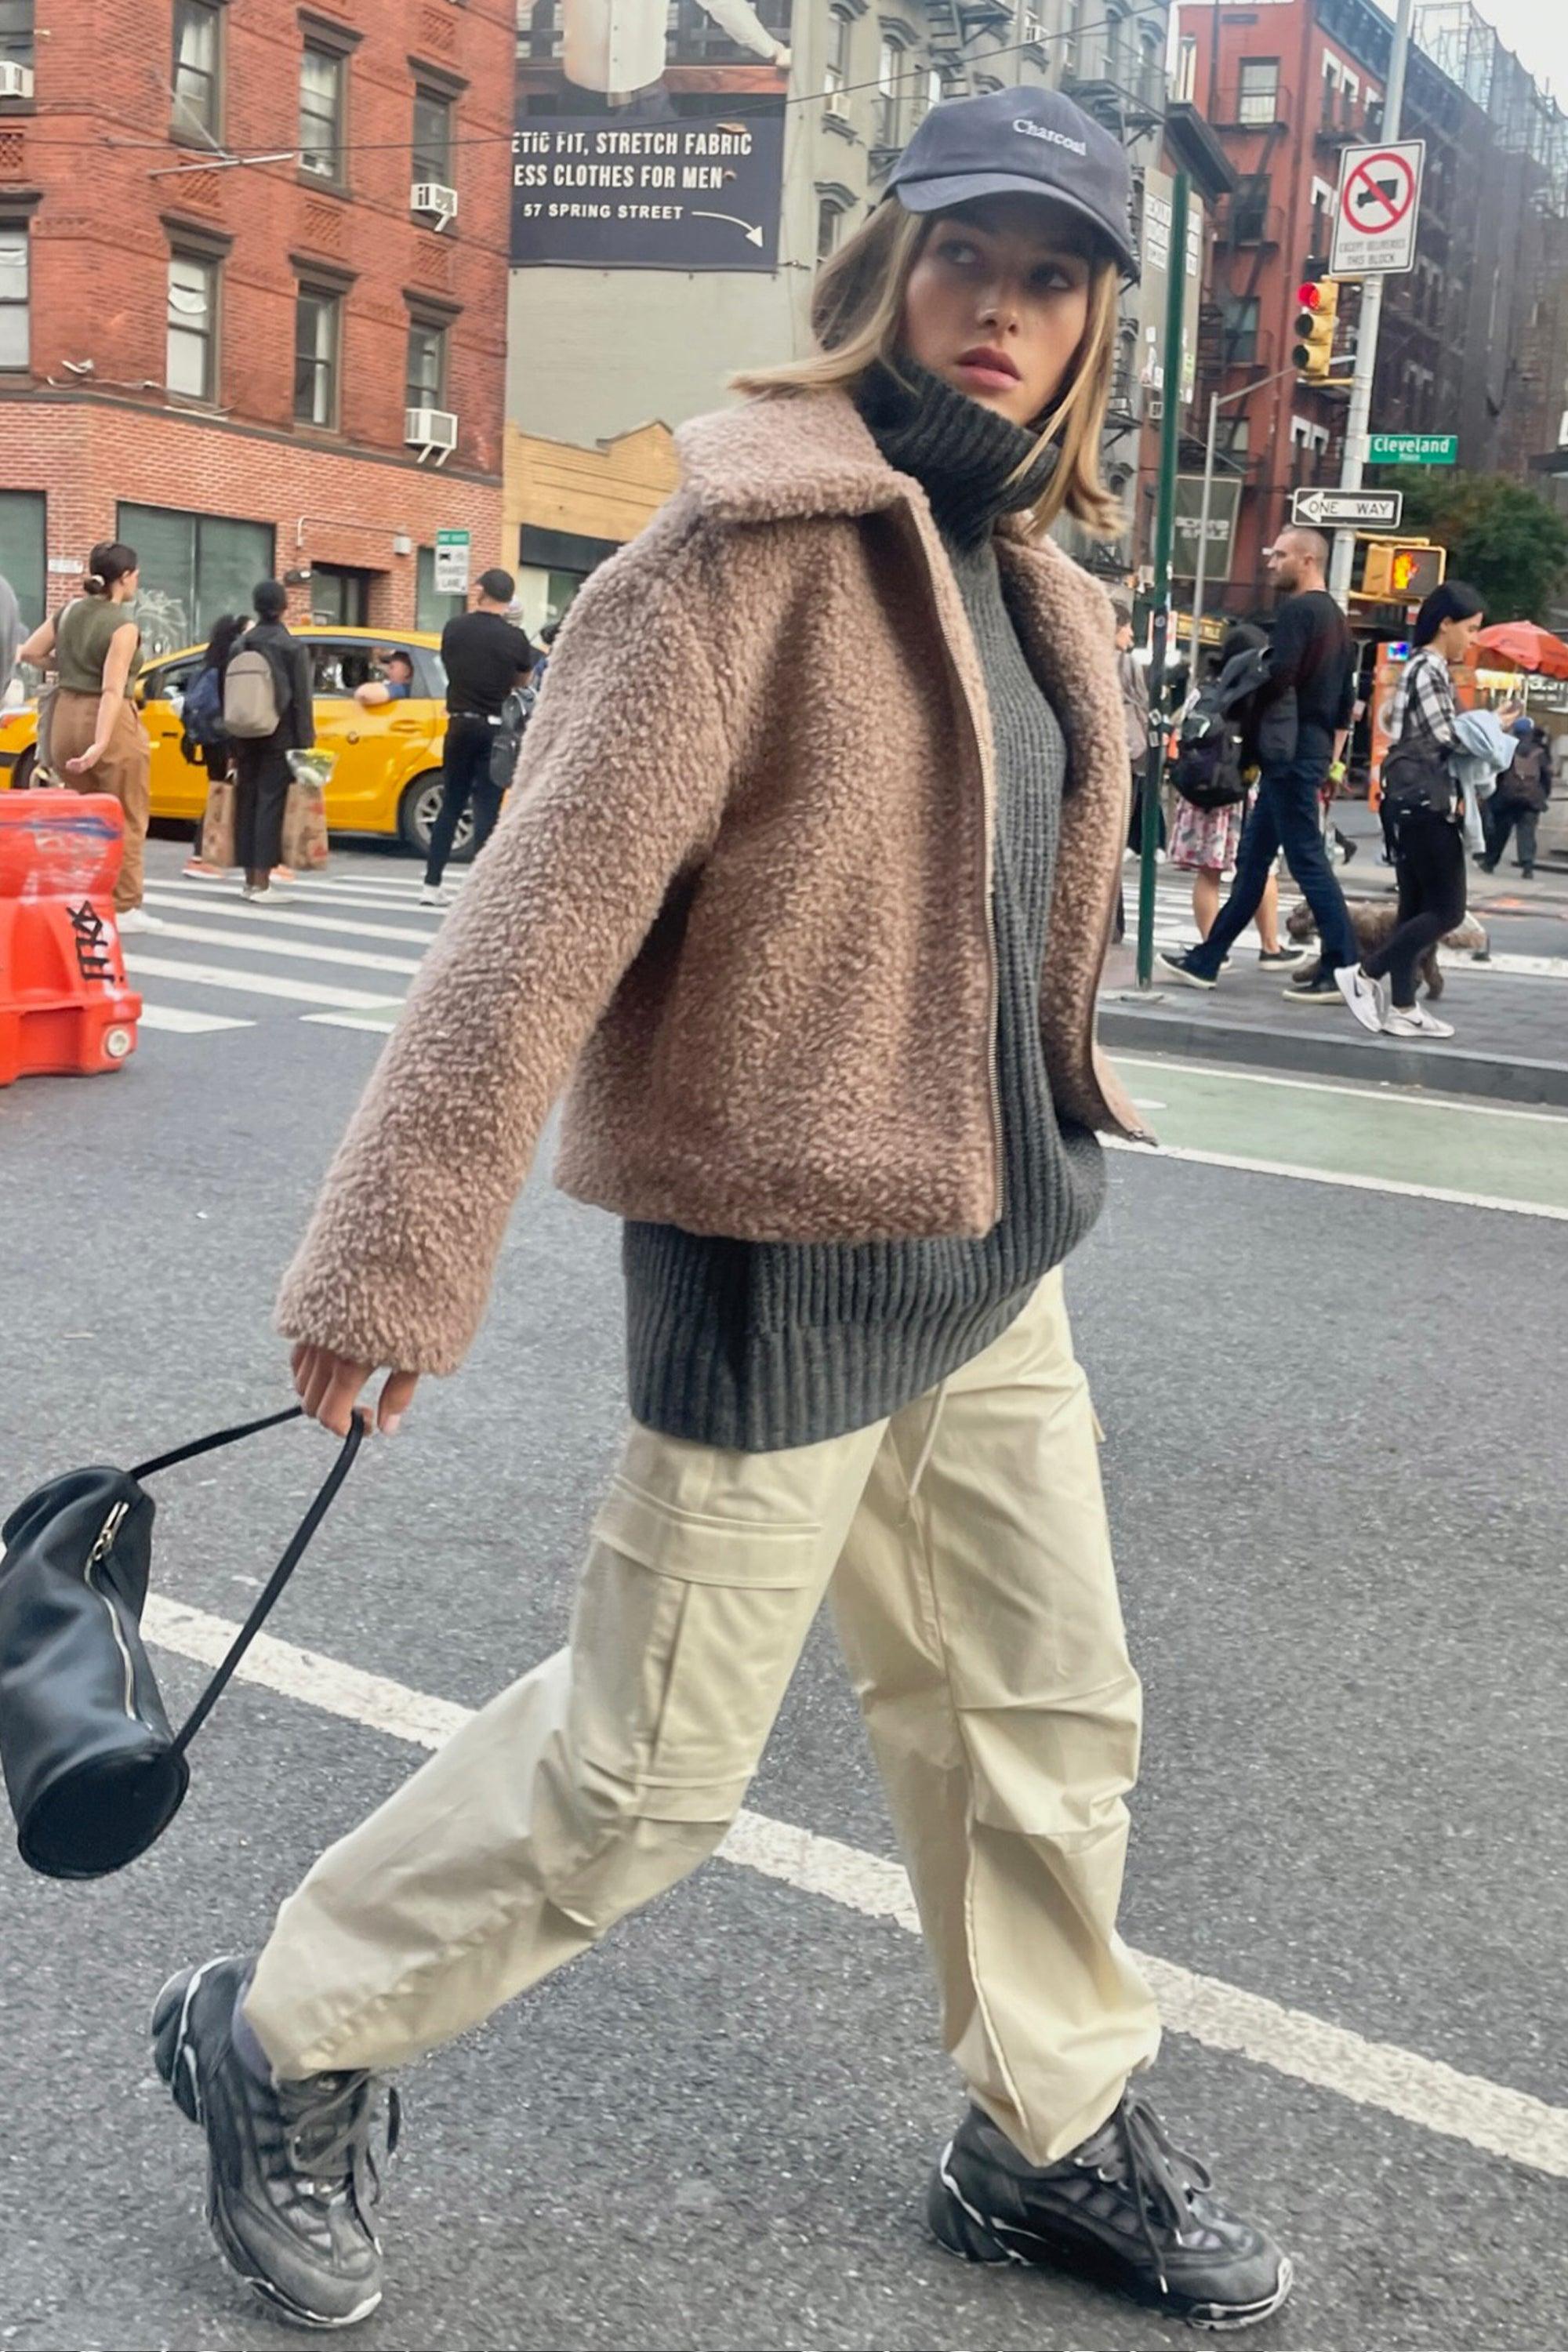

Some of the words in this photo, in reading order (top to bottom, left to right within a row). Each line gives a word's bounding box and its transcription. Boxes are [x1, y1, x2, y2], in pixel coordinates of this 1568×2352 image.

[555, 132, 589, 156] FIT,
[596, 132, 678, 154] STRETCH
[684, 132, 753, 155] FABRIC
[1012, 118, 1087, 156] Charcoal
[514, 164, 547, 187] ESS
[553, 164, 635, 187] CLOTHES
[641, 165, 676, 188] FOR
[682, 166, 723, 189] MEN
[523, 203, 543, 217] 57
[548, 203, 612, 219] SPRING
[617, 205, 684, 220] STREET
[1367, 253, 1395, 265] BLOCK
[1373, 437, 1450, 453] Cleveland
[1308, 500, 1338, 514] ONE
[1356, 502, 1390, 515] WAY
